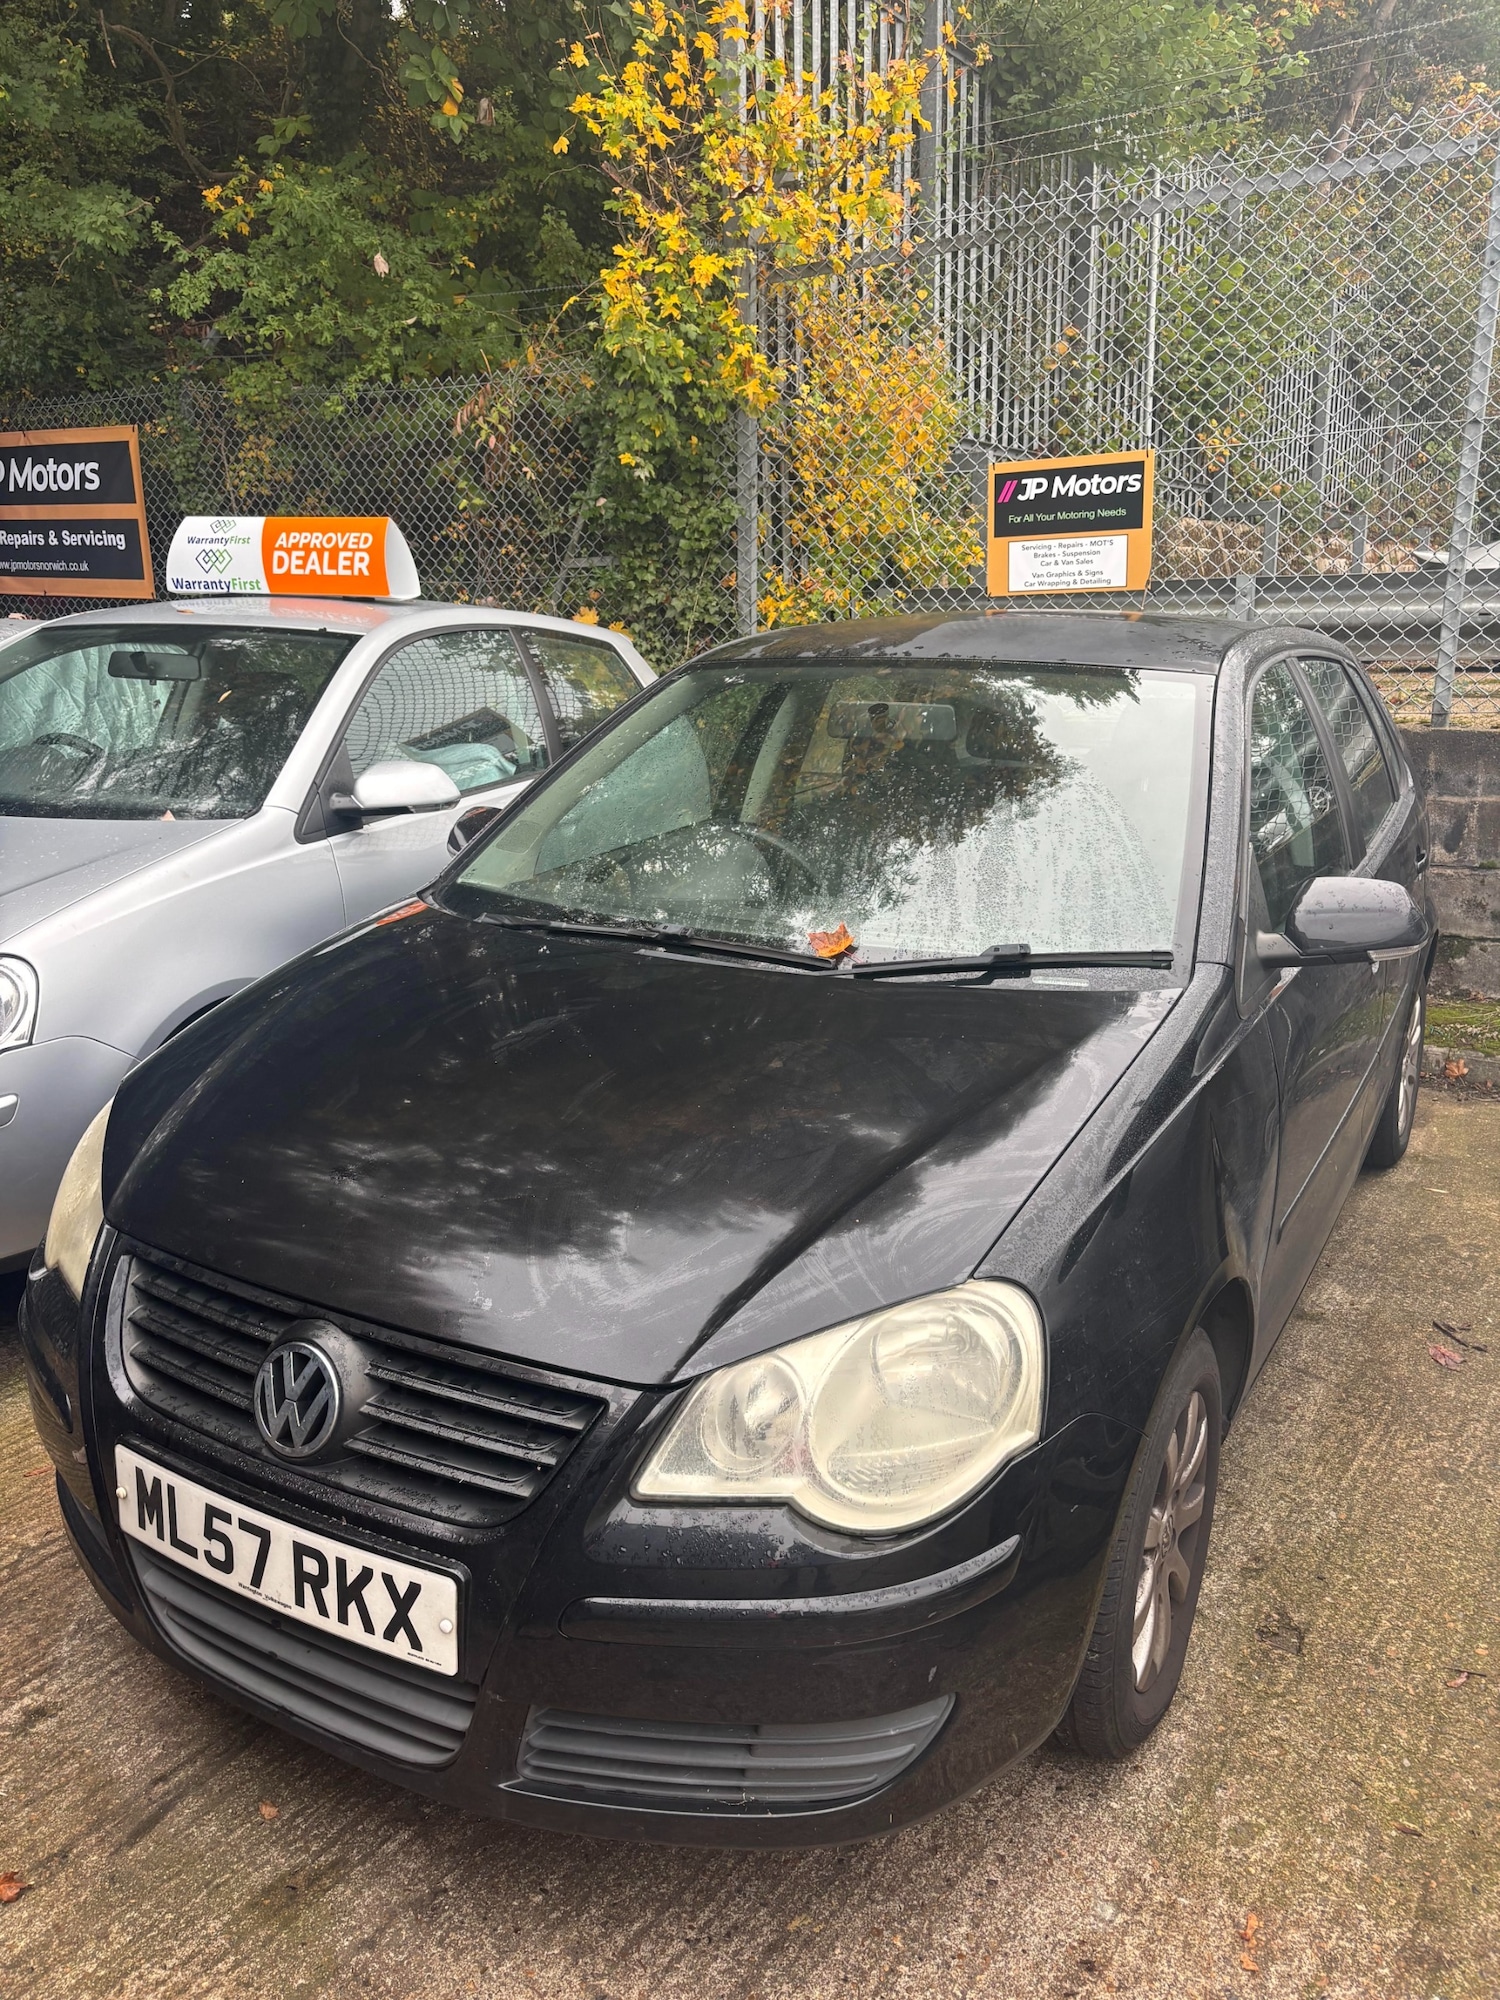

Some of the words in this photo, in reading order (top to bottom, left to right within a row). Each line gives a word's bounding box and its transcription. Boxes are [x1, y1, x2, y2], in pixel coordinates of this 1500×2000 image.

[9, 457, 100, 492] Motors
[1017, 477, 1048, 501] JP
[1051, 473, 1142, 498] Motors
[1008, 514, 1022, 524] For
[1023, 513, 1034, 522] All
[1036, 512, 1055, 522] Your
[1057, 510, 1095, 521] Motoring
[1097, 507, 1127, 517] Needs
[0, 530, 45, 549] Repairs
[48, 530, 59, 546] &
[61, 530, 126, 550] Servicing
[187, 535, 251, 547] WarrantyFirst
[275, 532, 373, 549] APPROVED
[1058, 542, 1084, 550] Repairs
[1062, 550, 1101, 558] Suspension
[272, 551, 370, 576] DEALER
[1037, 579, 1071, 588] Wrapping
[1080, 577, 1112, 585] Detailing
[1046, 571, 1076, 579] Graphics
[1085, 569, 1104, 578] Signs
[171, 577, 261, 593] WarrantyFirst
[135, 1466, 271, 1588] ML57
[292, 1539, 423, 1652] RKX
